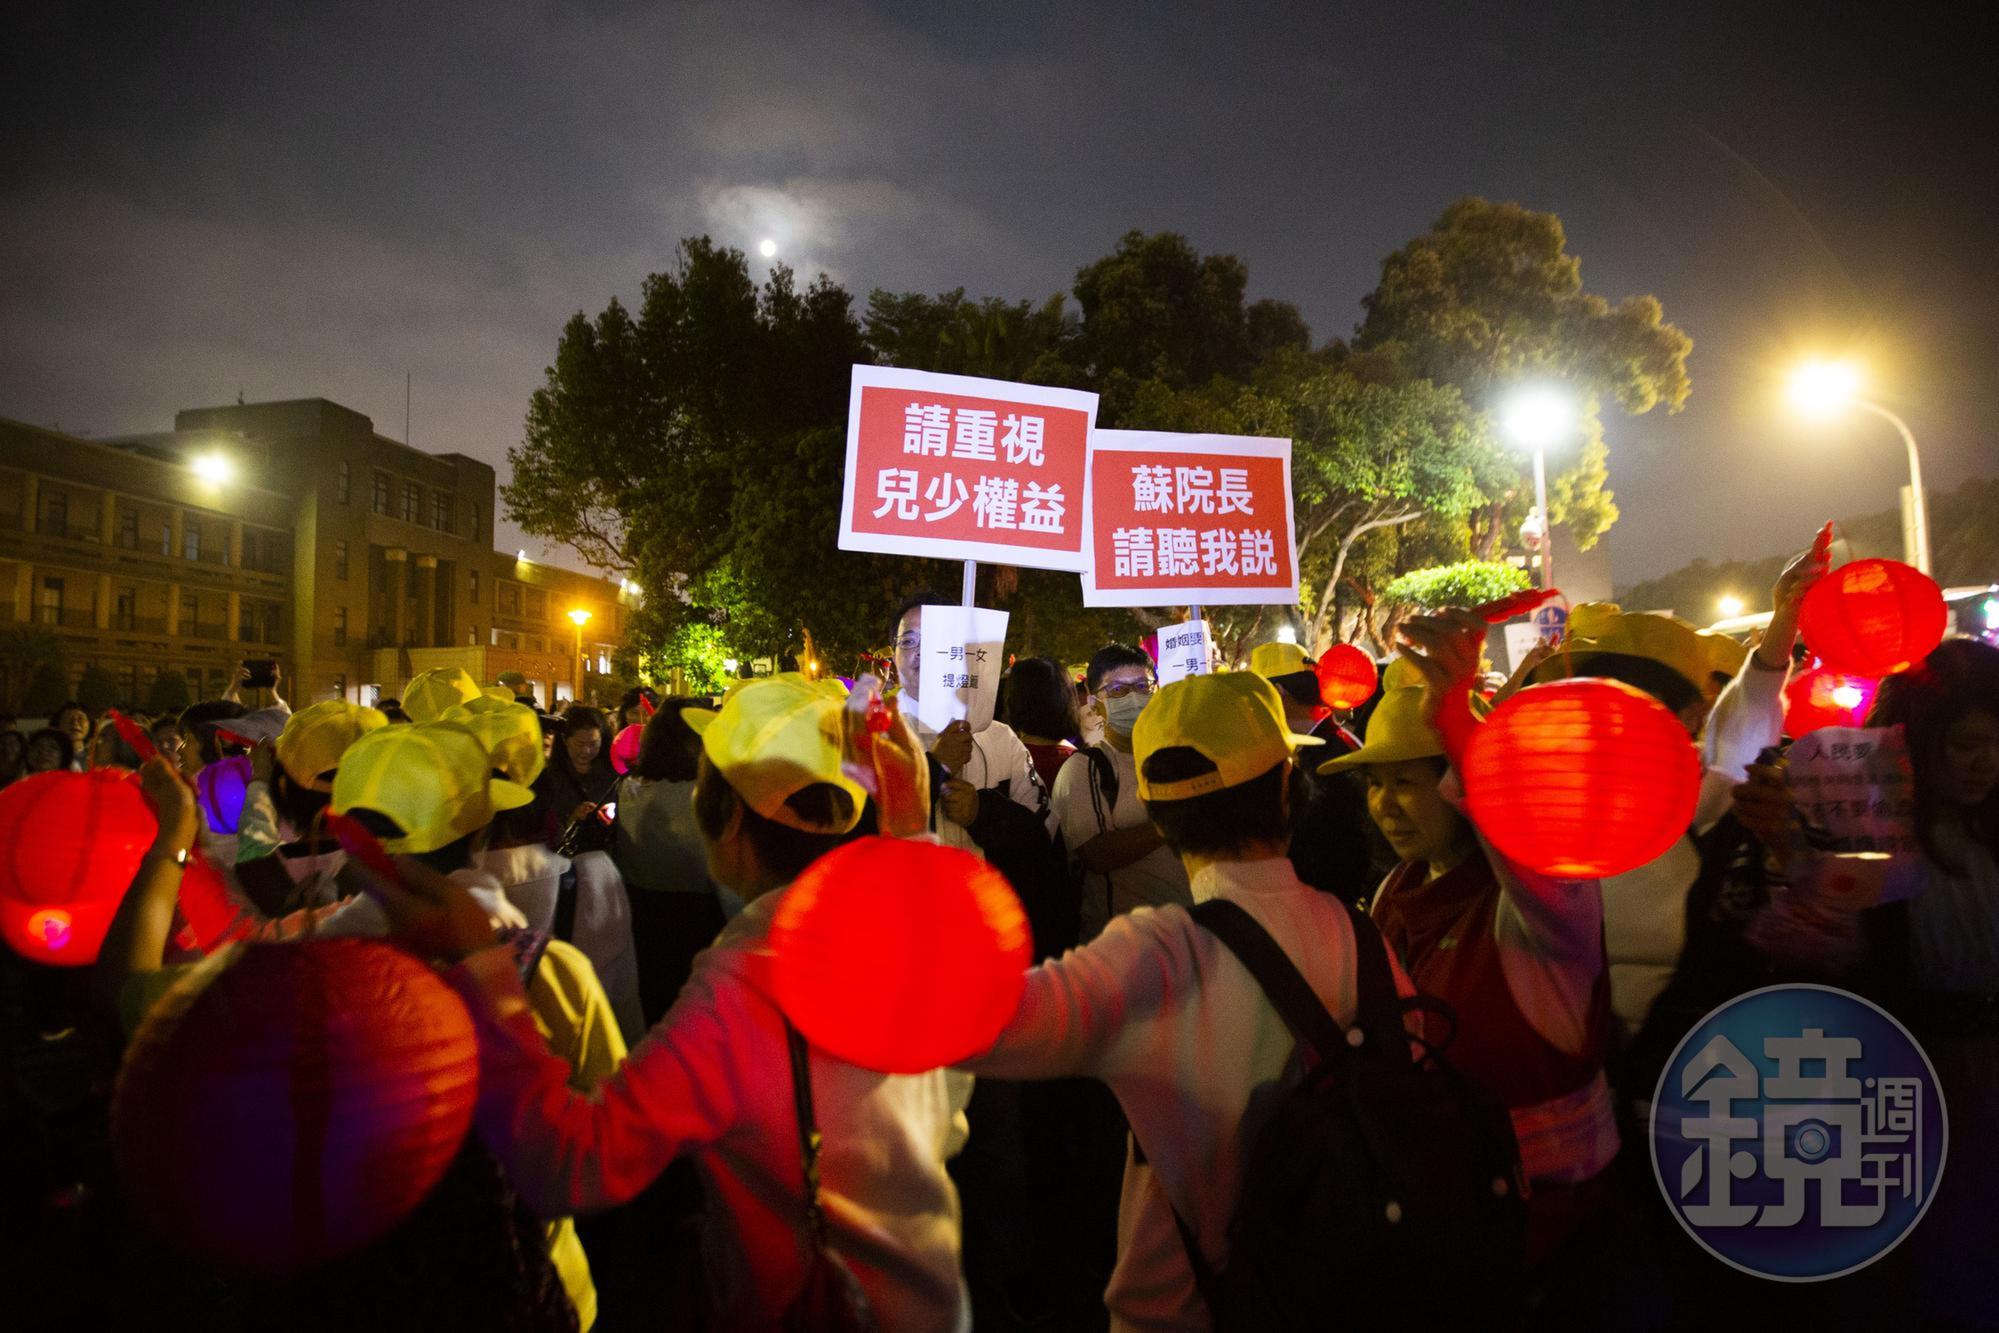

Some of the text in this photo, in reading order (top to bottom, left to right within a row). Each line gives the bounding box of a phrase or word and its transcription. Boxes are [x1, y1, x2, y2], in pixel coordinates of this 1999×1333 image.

[902, 402, 1046, 467] 請重視
[872, 467, 1066, 534] 兒少權益
[1131, 464, 1255, 516] 蘇院長
[936, 646, 988, 663] 一男一女
[1165, 632, 1205, 651] 婚姻要
